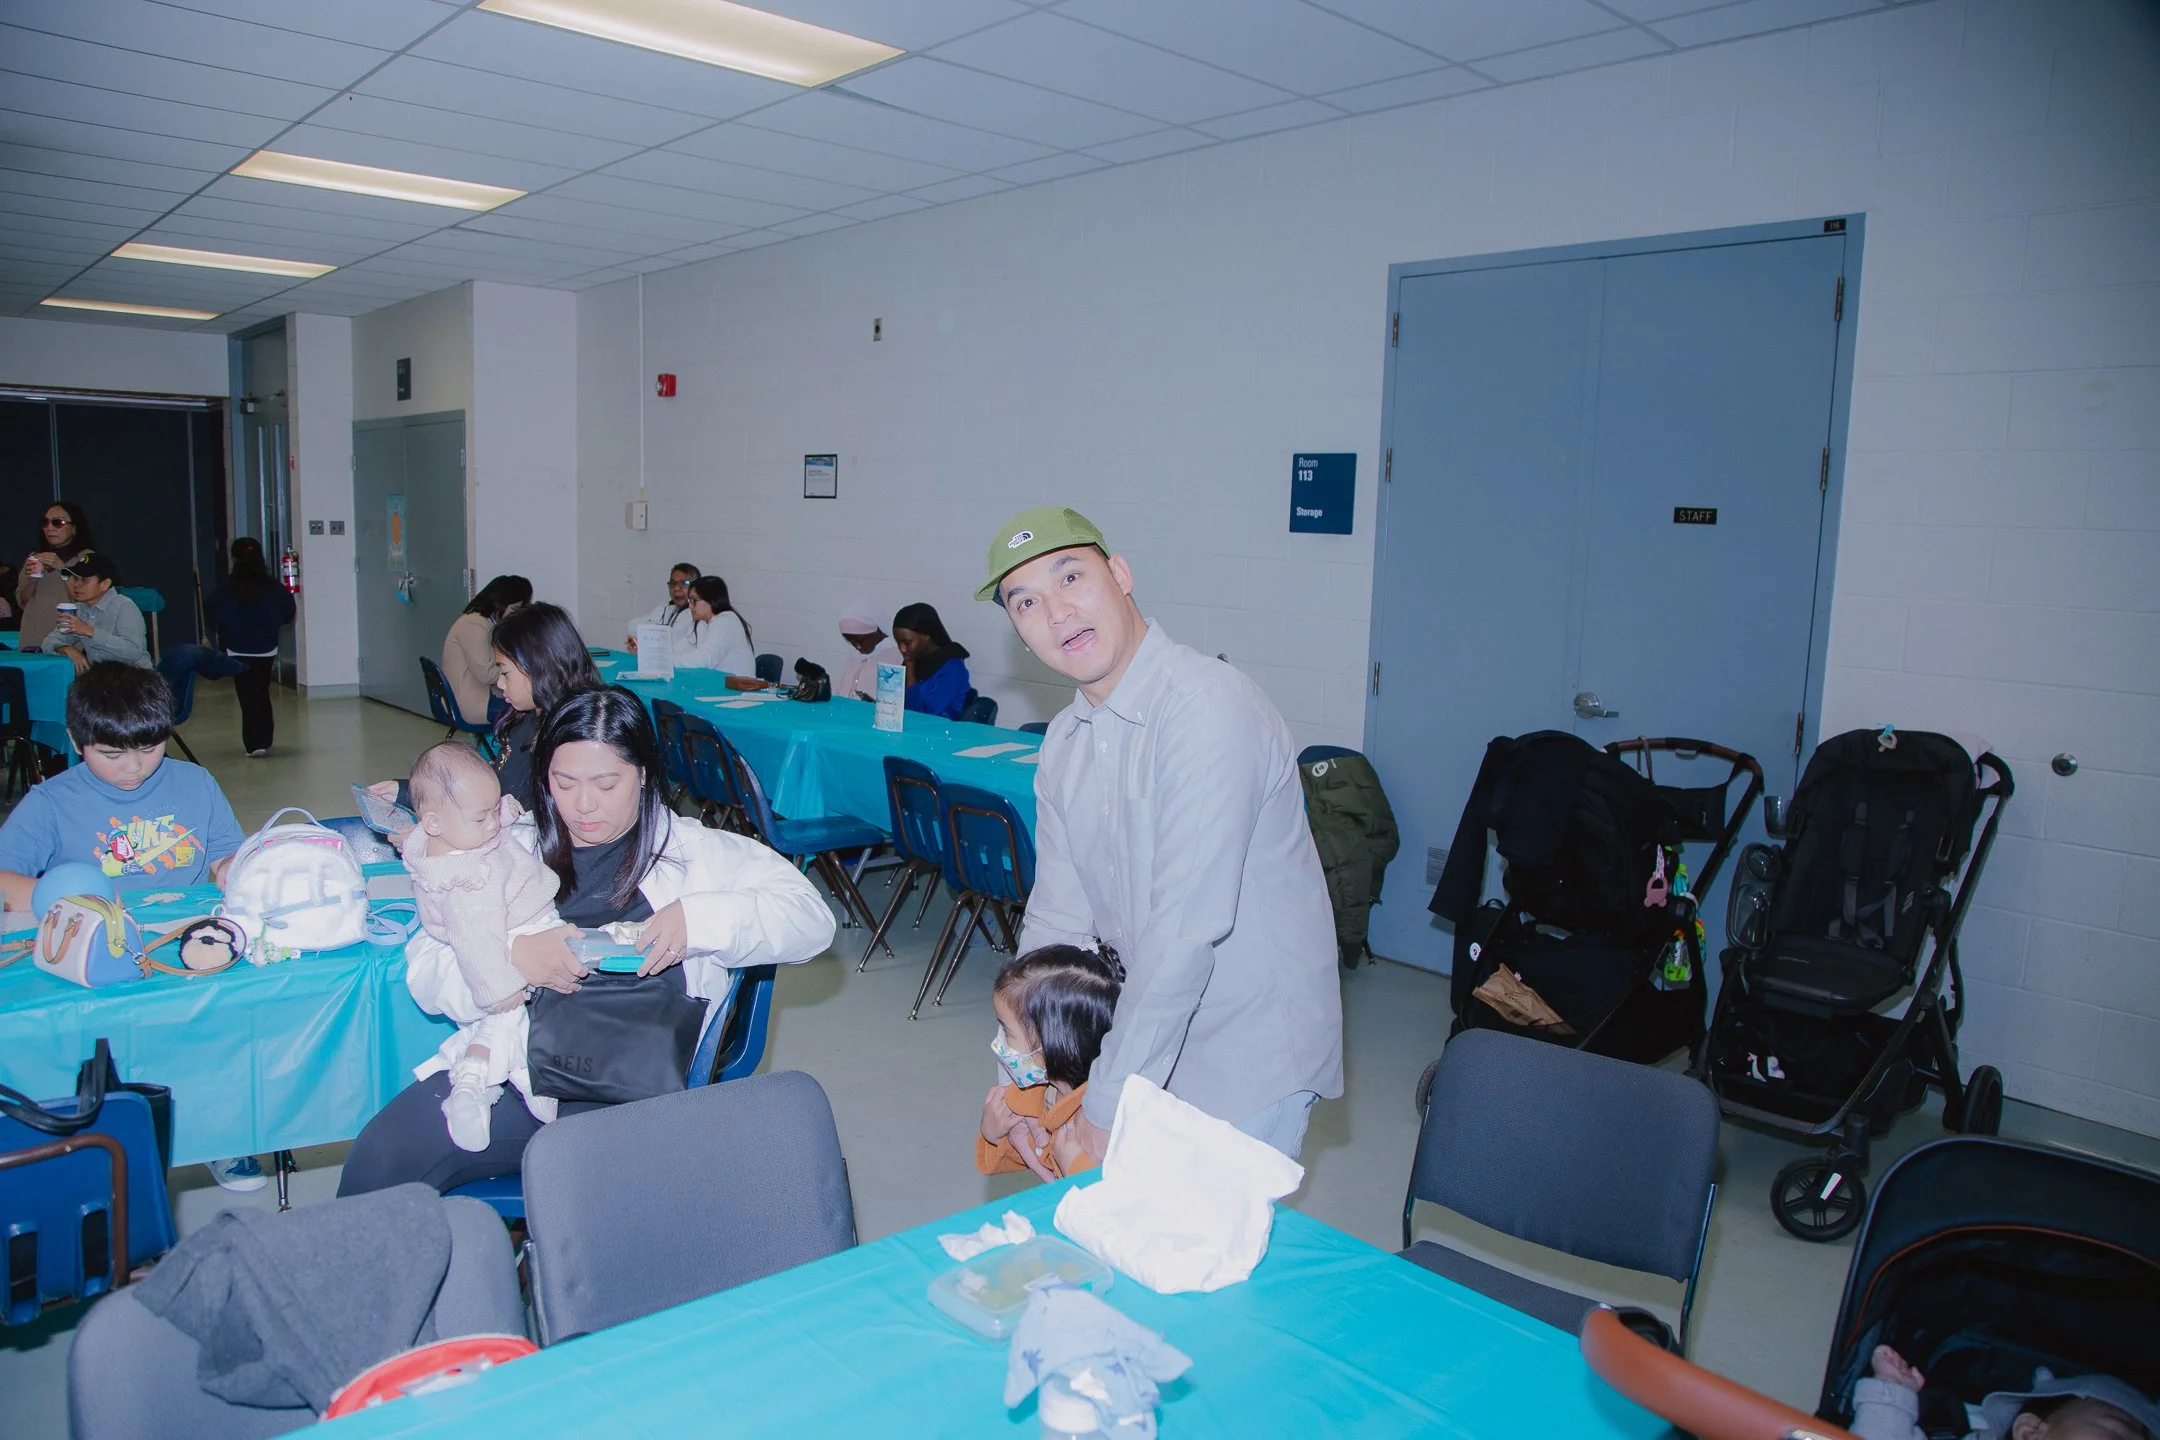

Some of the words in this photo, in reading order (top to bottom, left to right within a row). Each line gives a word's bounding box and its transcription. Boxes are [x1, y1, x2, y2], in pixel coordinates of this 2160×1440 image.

[1298, 457, 1318, 468] Room
[1298, 470, 1313, 481] 113
[1296, 507, 1323, 519] Storage
[1680, 510, 1713, 522] STAFF
